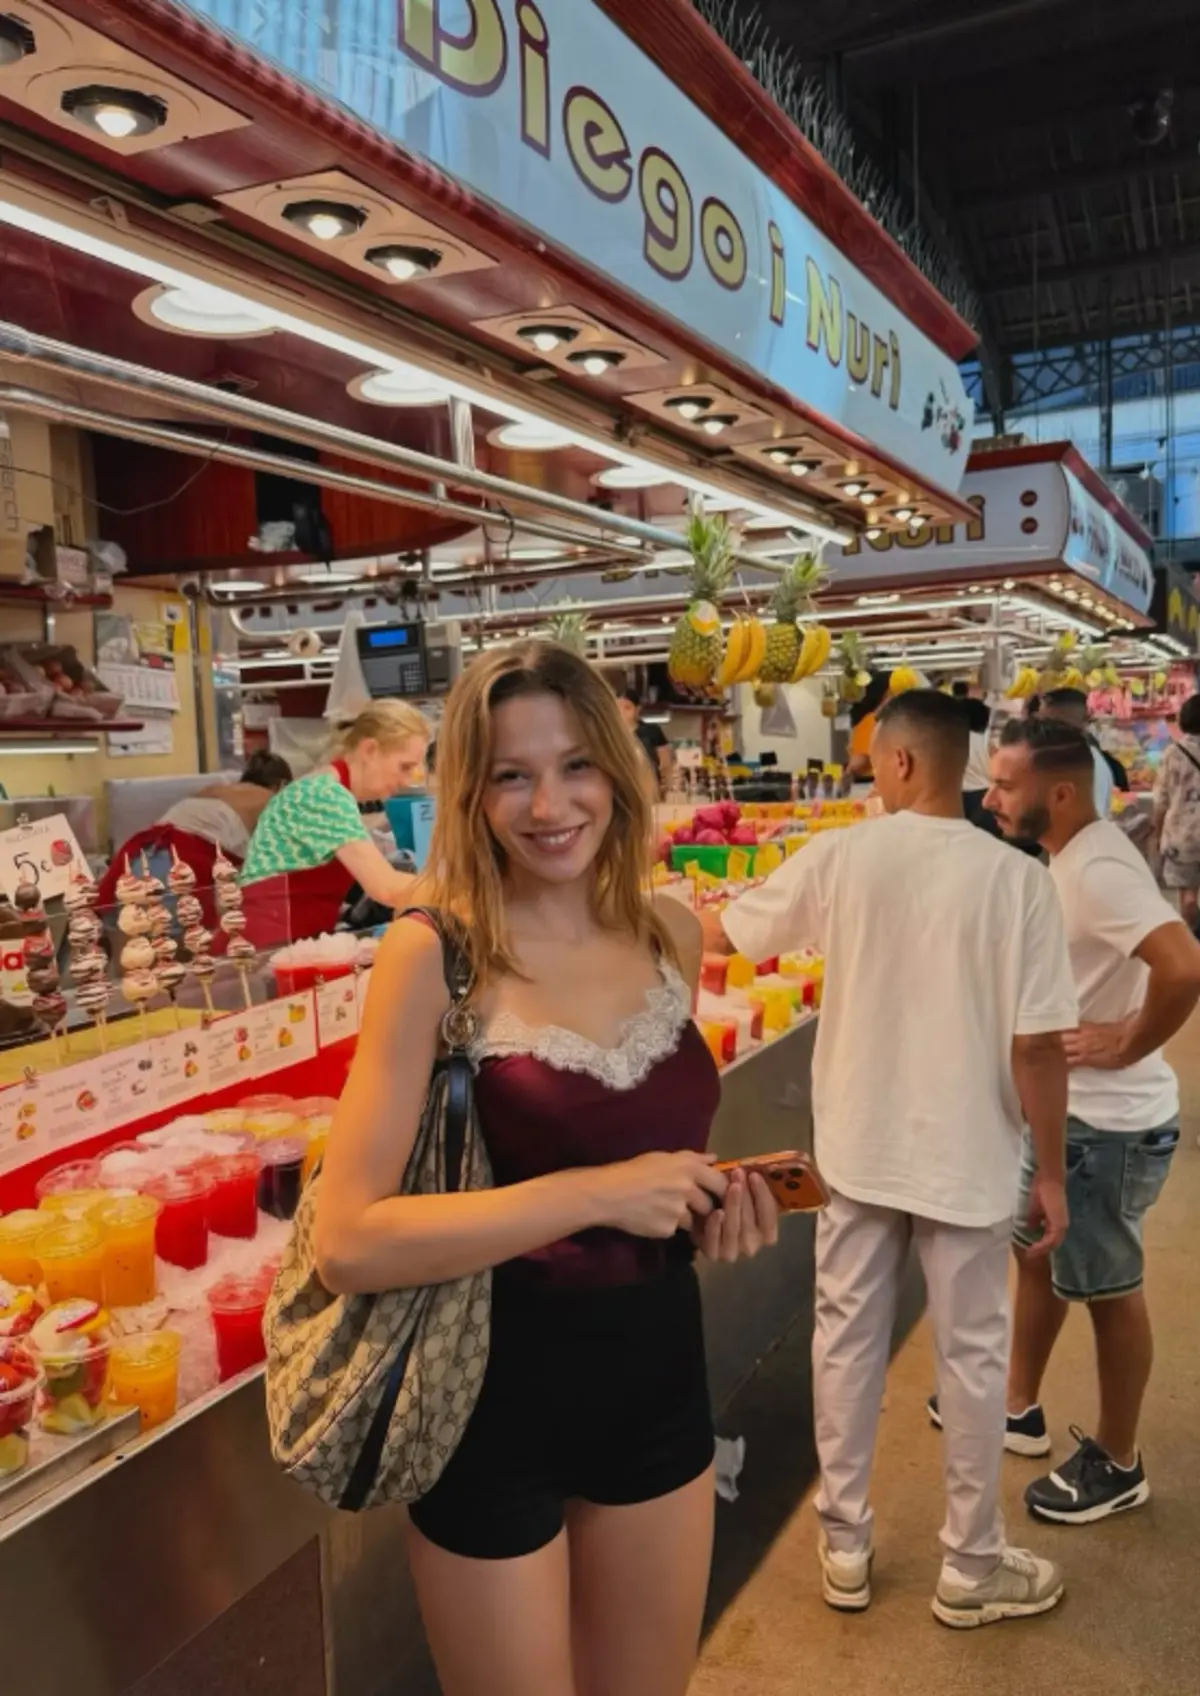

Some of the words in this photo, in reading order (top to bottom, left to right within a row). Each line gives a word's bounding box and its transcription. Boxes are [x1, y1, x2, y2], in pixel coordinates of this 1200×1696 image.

[397, 0, 747, 291] Diego
[767, 220, 786, 327] i
[805, 254, 901, 411] Nuri
